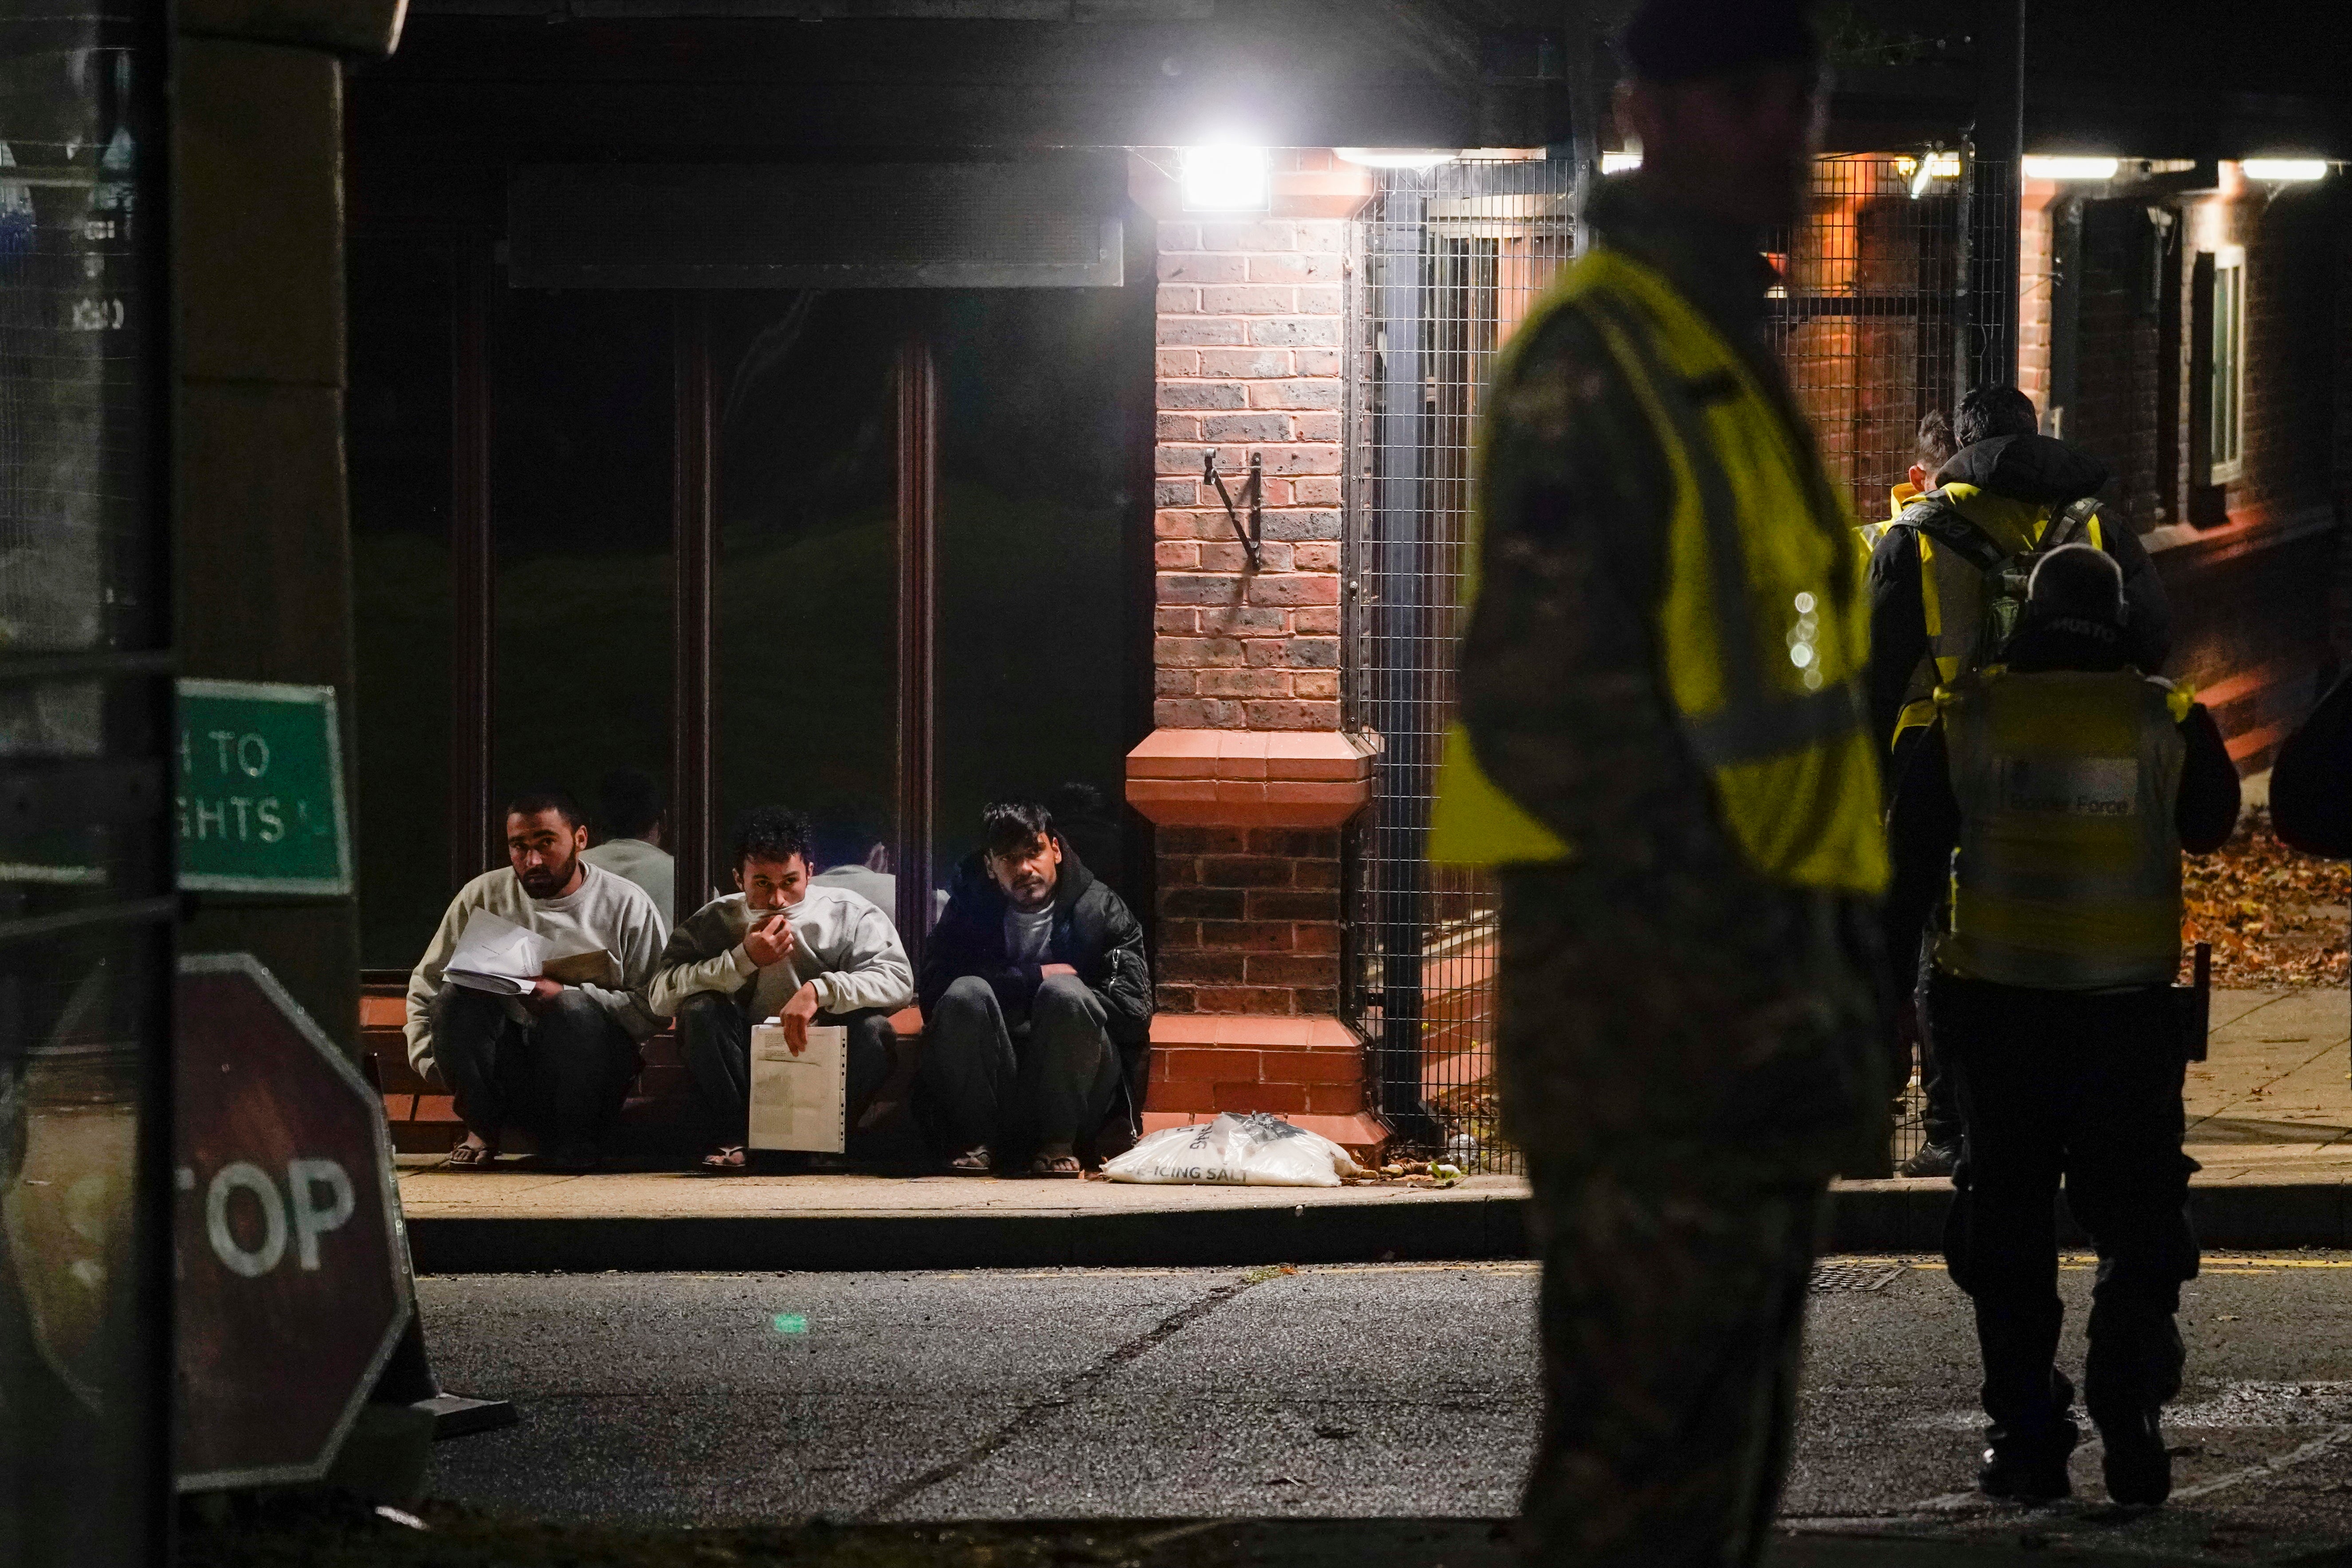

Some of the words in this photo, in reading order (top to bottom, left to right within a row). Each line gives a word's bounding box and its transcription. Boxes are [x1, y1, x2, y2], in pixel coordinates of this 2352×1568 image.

[208, 731, 270, 777] TO
[2077, 795, 2128, 813] Force
[174, 1158, 356, 1278] OP
